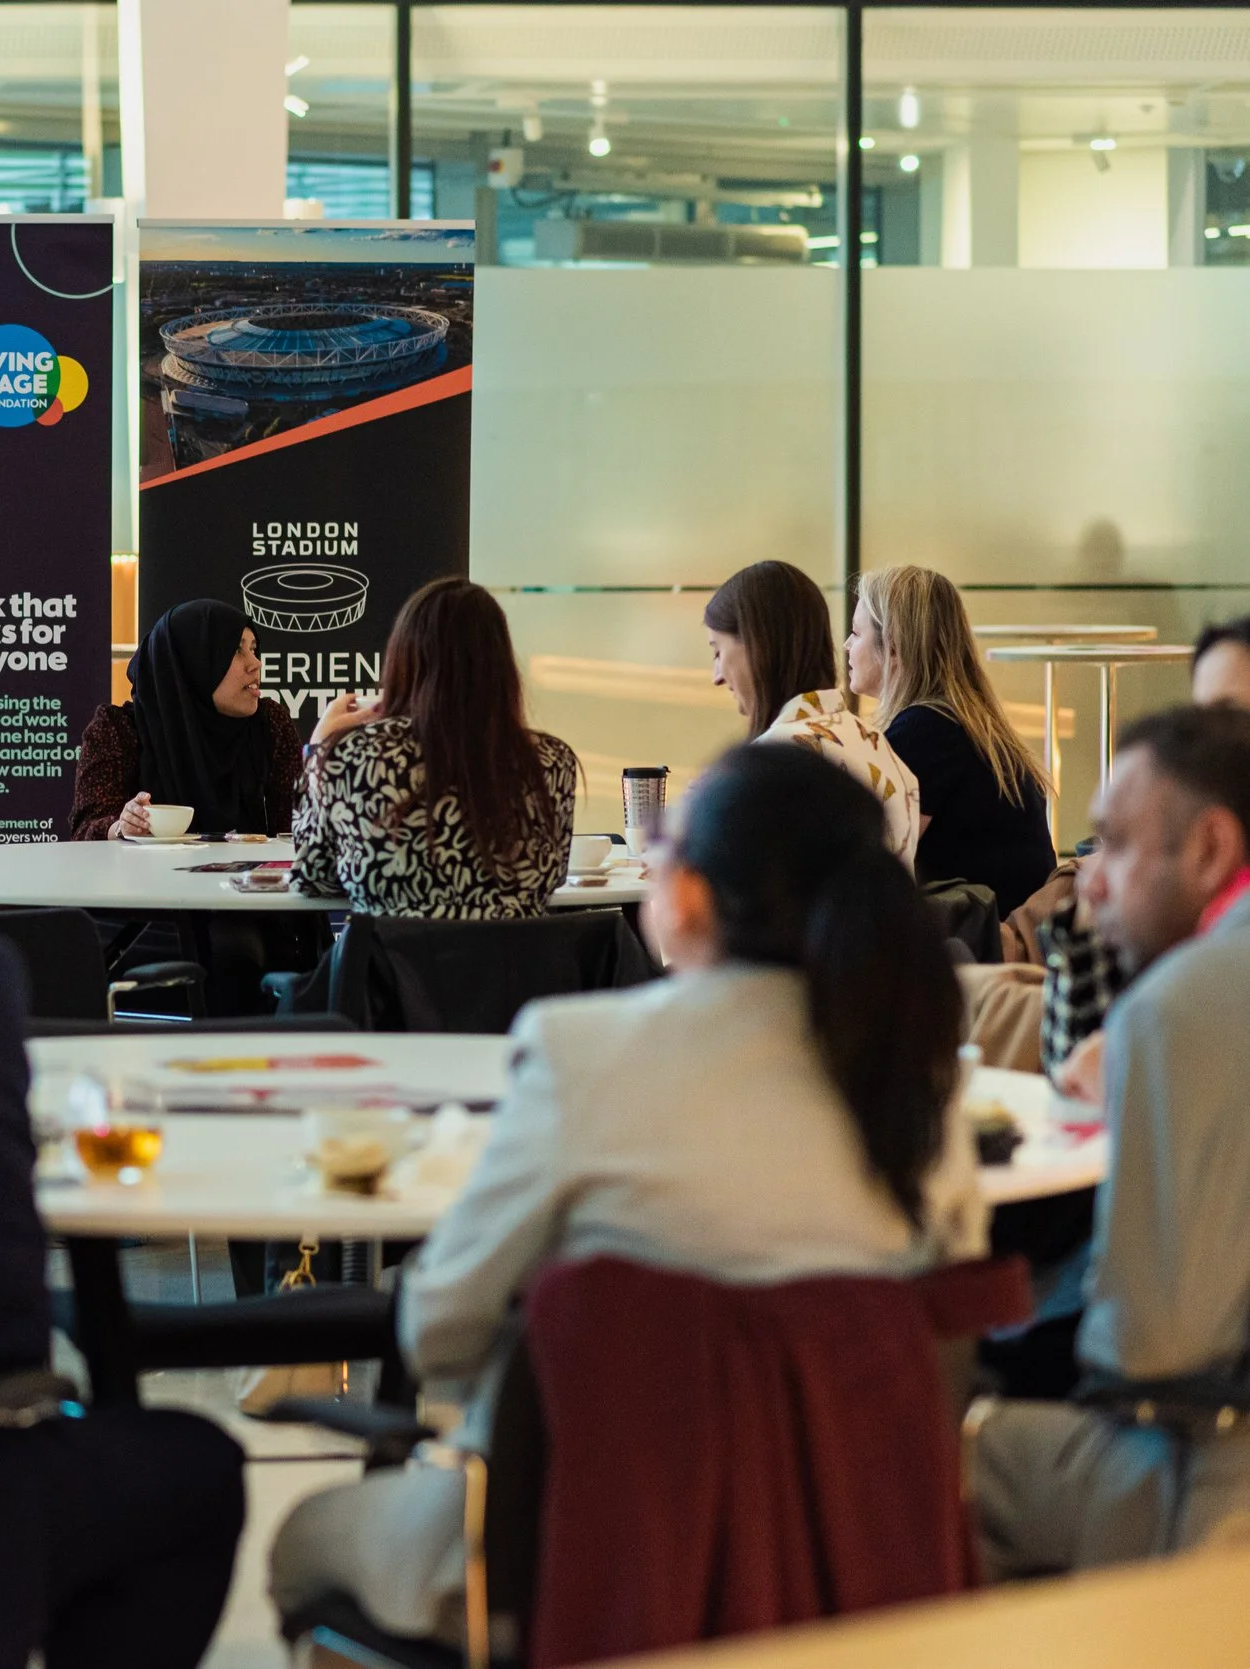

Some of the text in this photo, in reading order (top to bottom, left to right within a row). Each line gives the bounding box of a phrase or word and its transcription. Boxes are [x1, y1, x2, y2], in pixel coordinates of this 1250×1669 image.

[252, 522, 358, 538] LONDON
[252, 540, 358, 556] STADIUM
[9, 592, 77, 618] that
[20, 618, 66, 645] for
[260, 652, 381, 683] ERIEN
[32, 695, 61, 710] the
[25, 713, 68, 727] work
[24, 729, 55, 744] has
[56, 732, 68, 744] a
[63, 745, 82, 761] of
[11, 763, 45, 777] and
[46, 763, 62, 777] in
[39, 818, 53, 829] of
[32, 831, 59, 843] who
